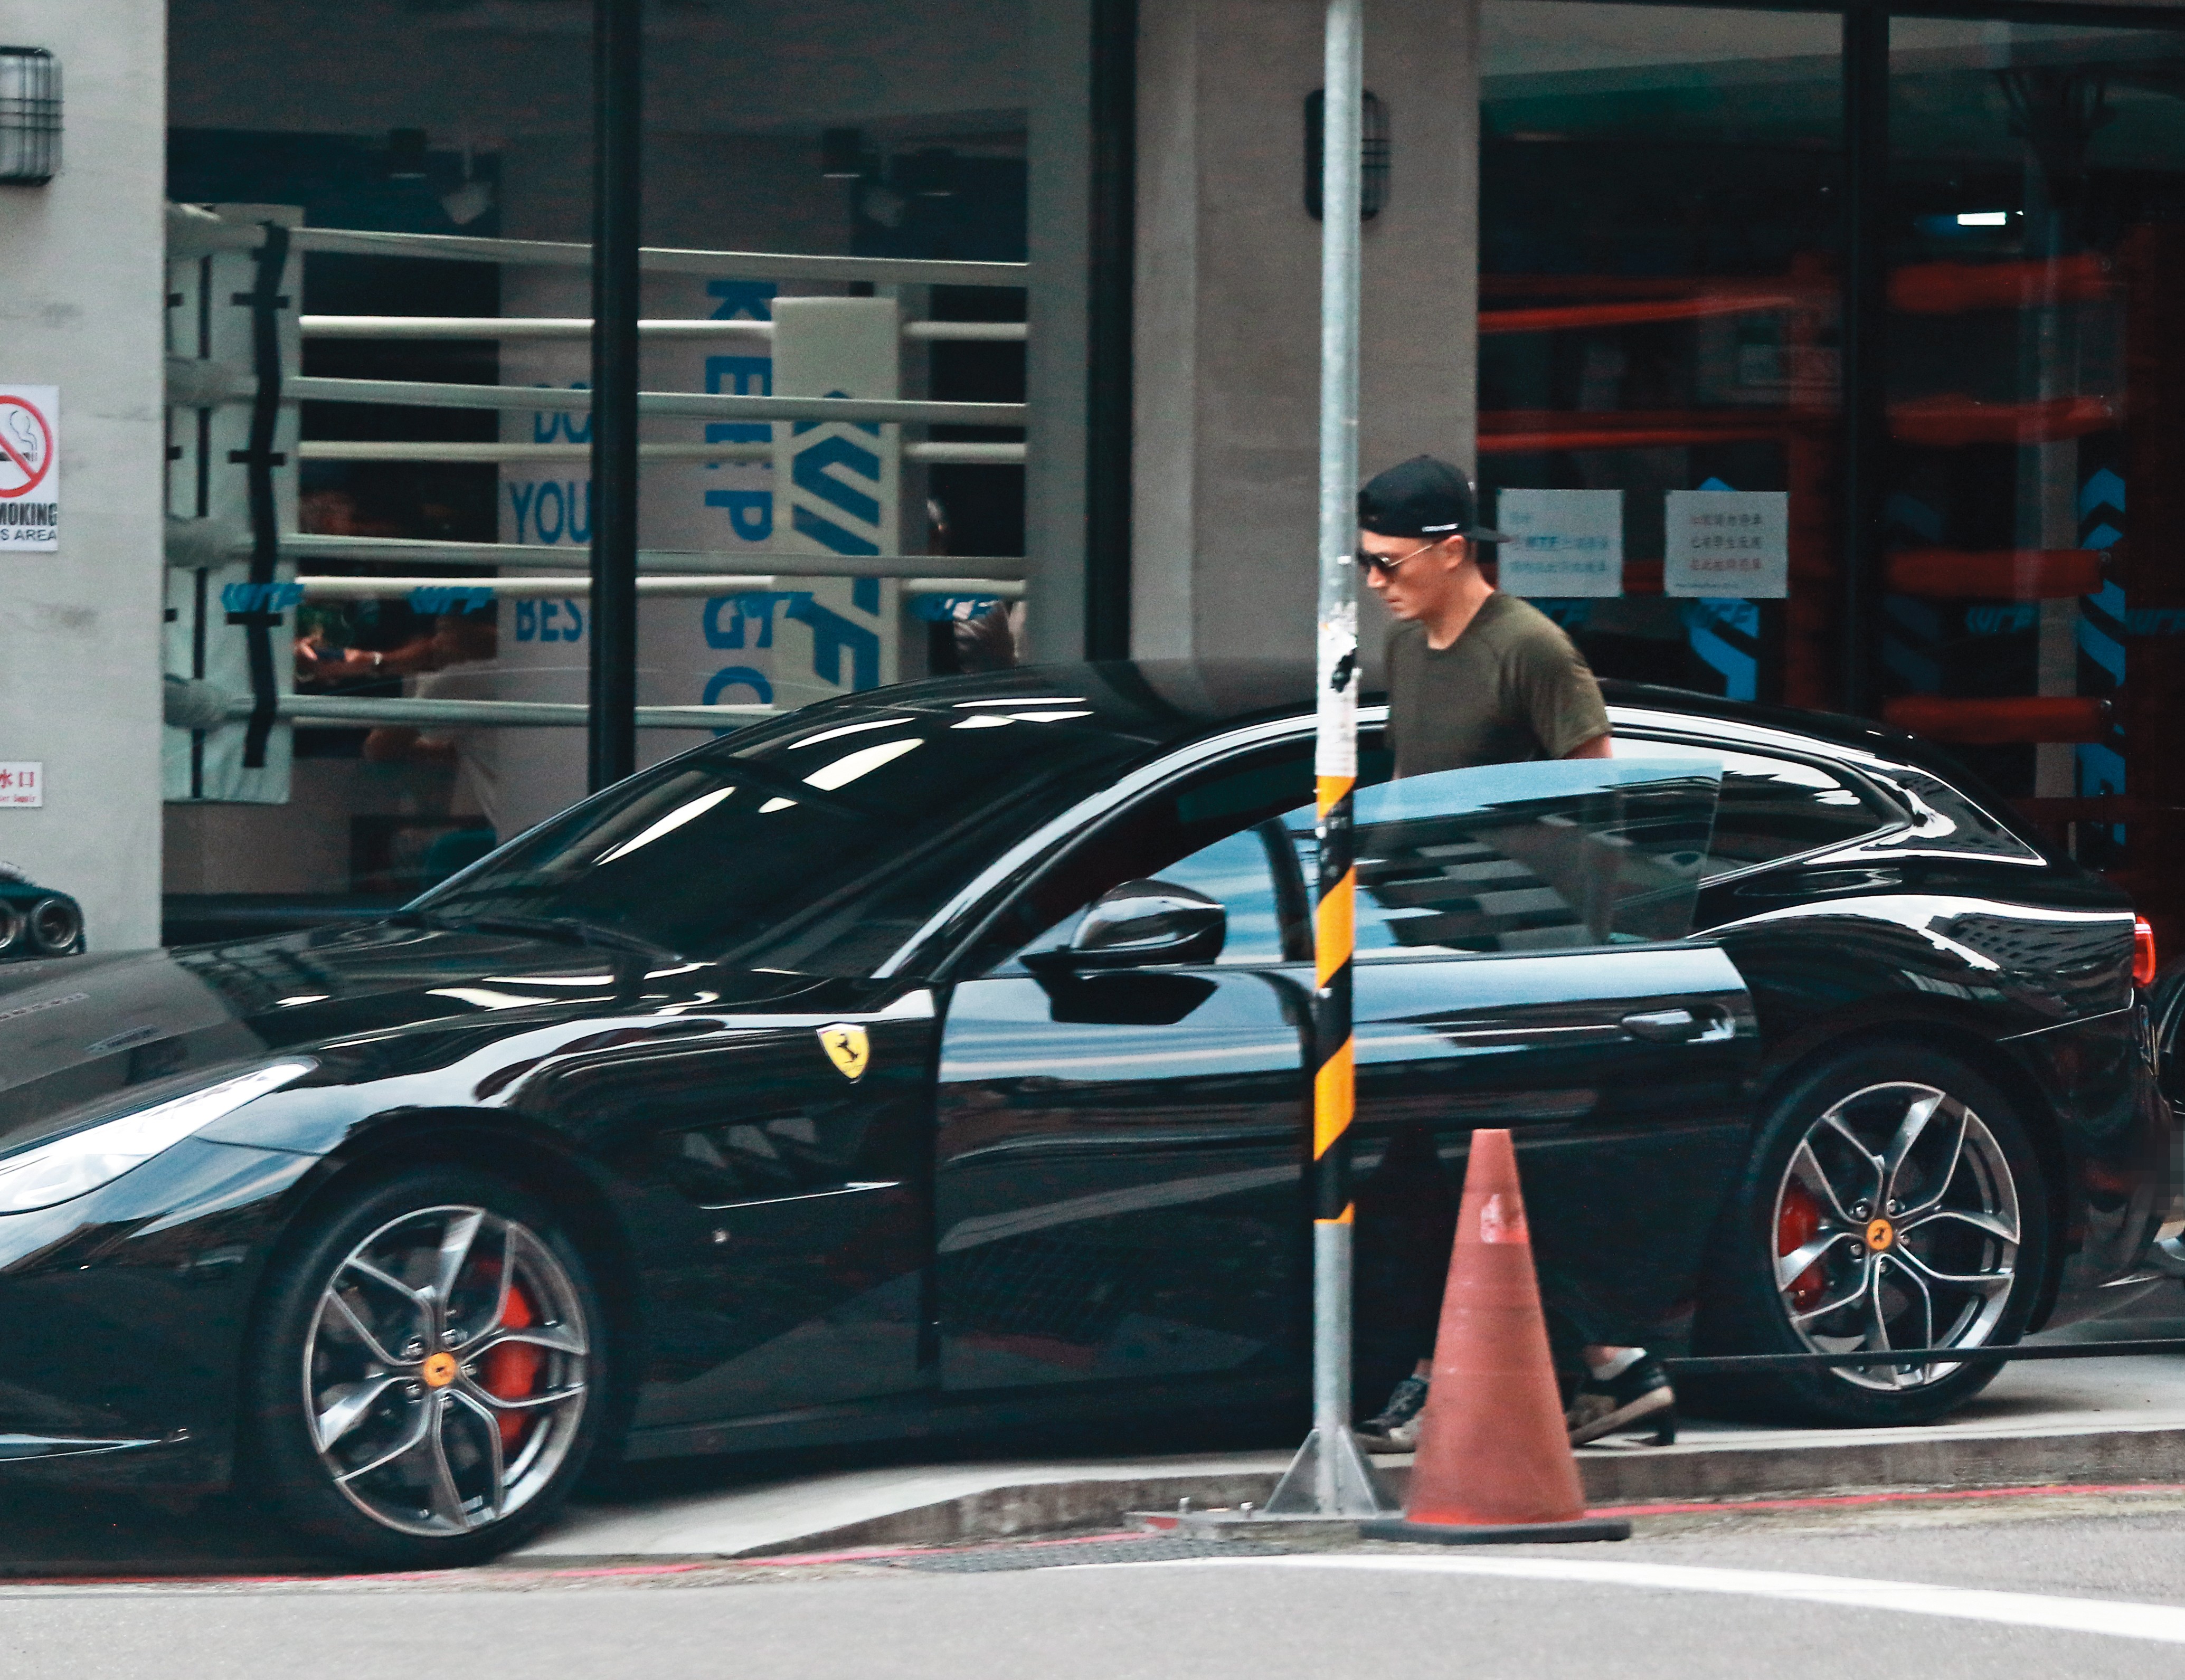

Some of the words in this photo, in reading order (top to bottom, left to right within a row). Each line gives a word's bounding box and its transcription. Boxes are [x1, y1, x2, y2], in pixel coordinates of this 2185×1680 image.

[510, 481, 593, 544] YOU
[14, 529, 56, 541] AREA
[516, 599, 592, 642] BES
